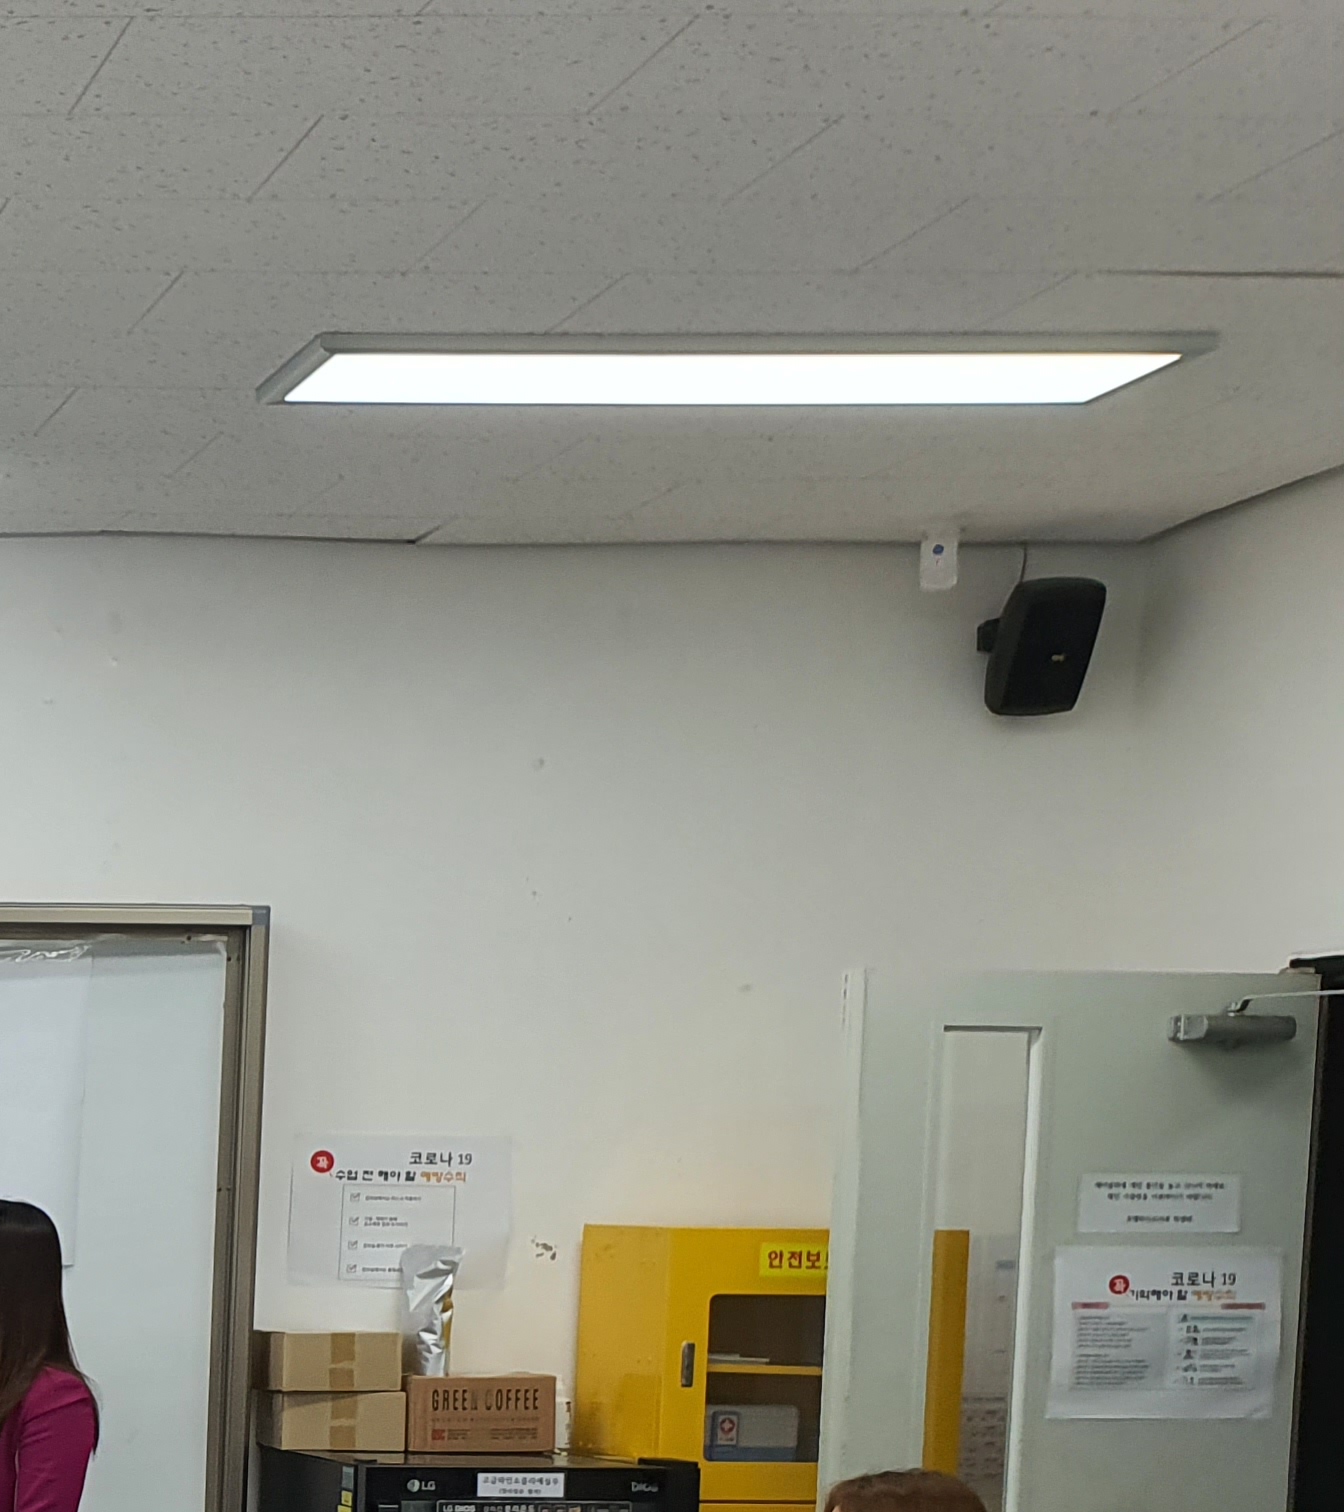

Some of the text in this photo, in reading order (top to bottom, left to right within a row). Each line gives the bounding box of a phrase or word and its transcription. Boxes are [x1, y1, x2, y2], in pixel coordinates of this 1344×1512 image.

[409, 1151, 473, 1167] 코로나 19
[335, 1169, 358, 1181] 수업
[768, 1250, 828, 1270] 안전보
[1171, 1271, 1237, 1288] 코로나 19
[431, 1388, 539, 1411] GREEN COFFEE
[421, 1481, 436, 1491] LG
